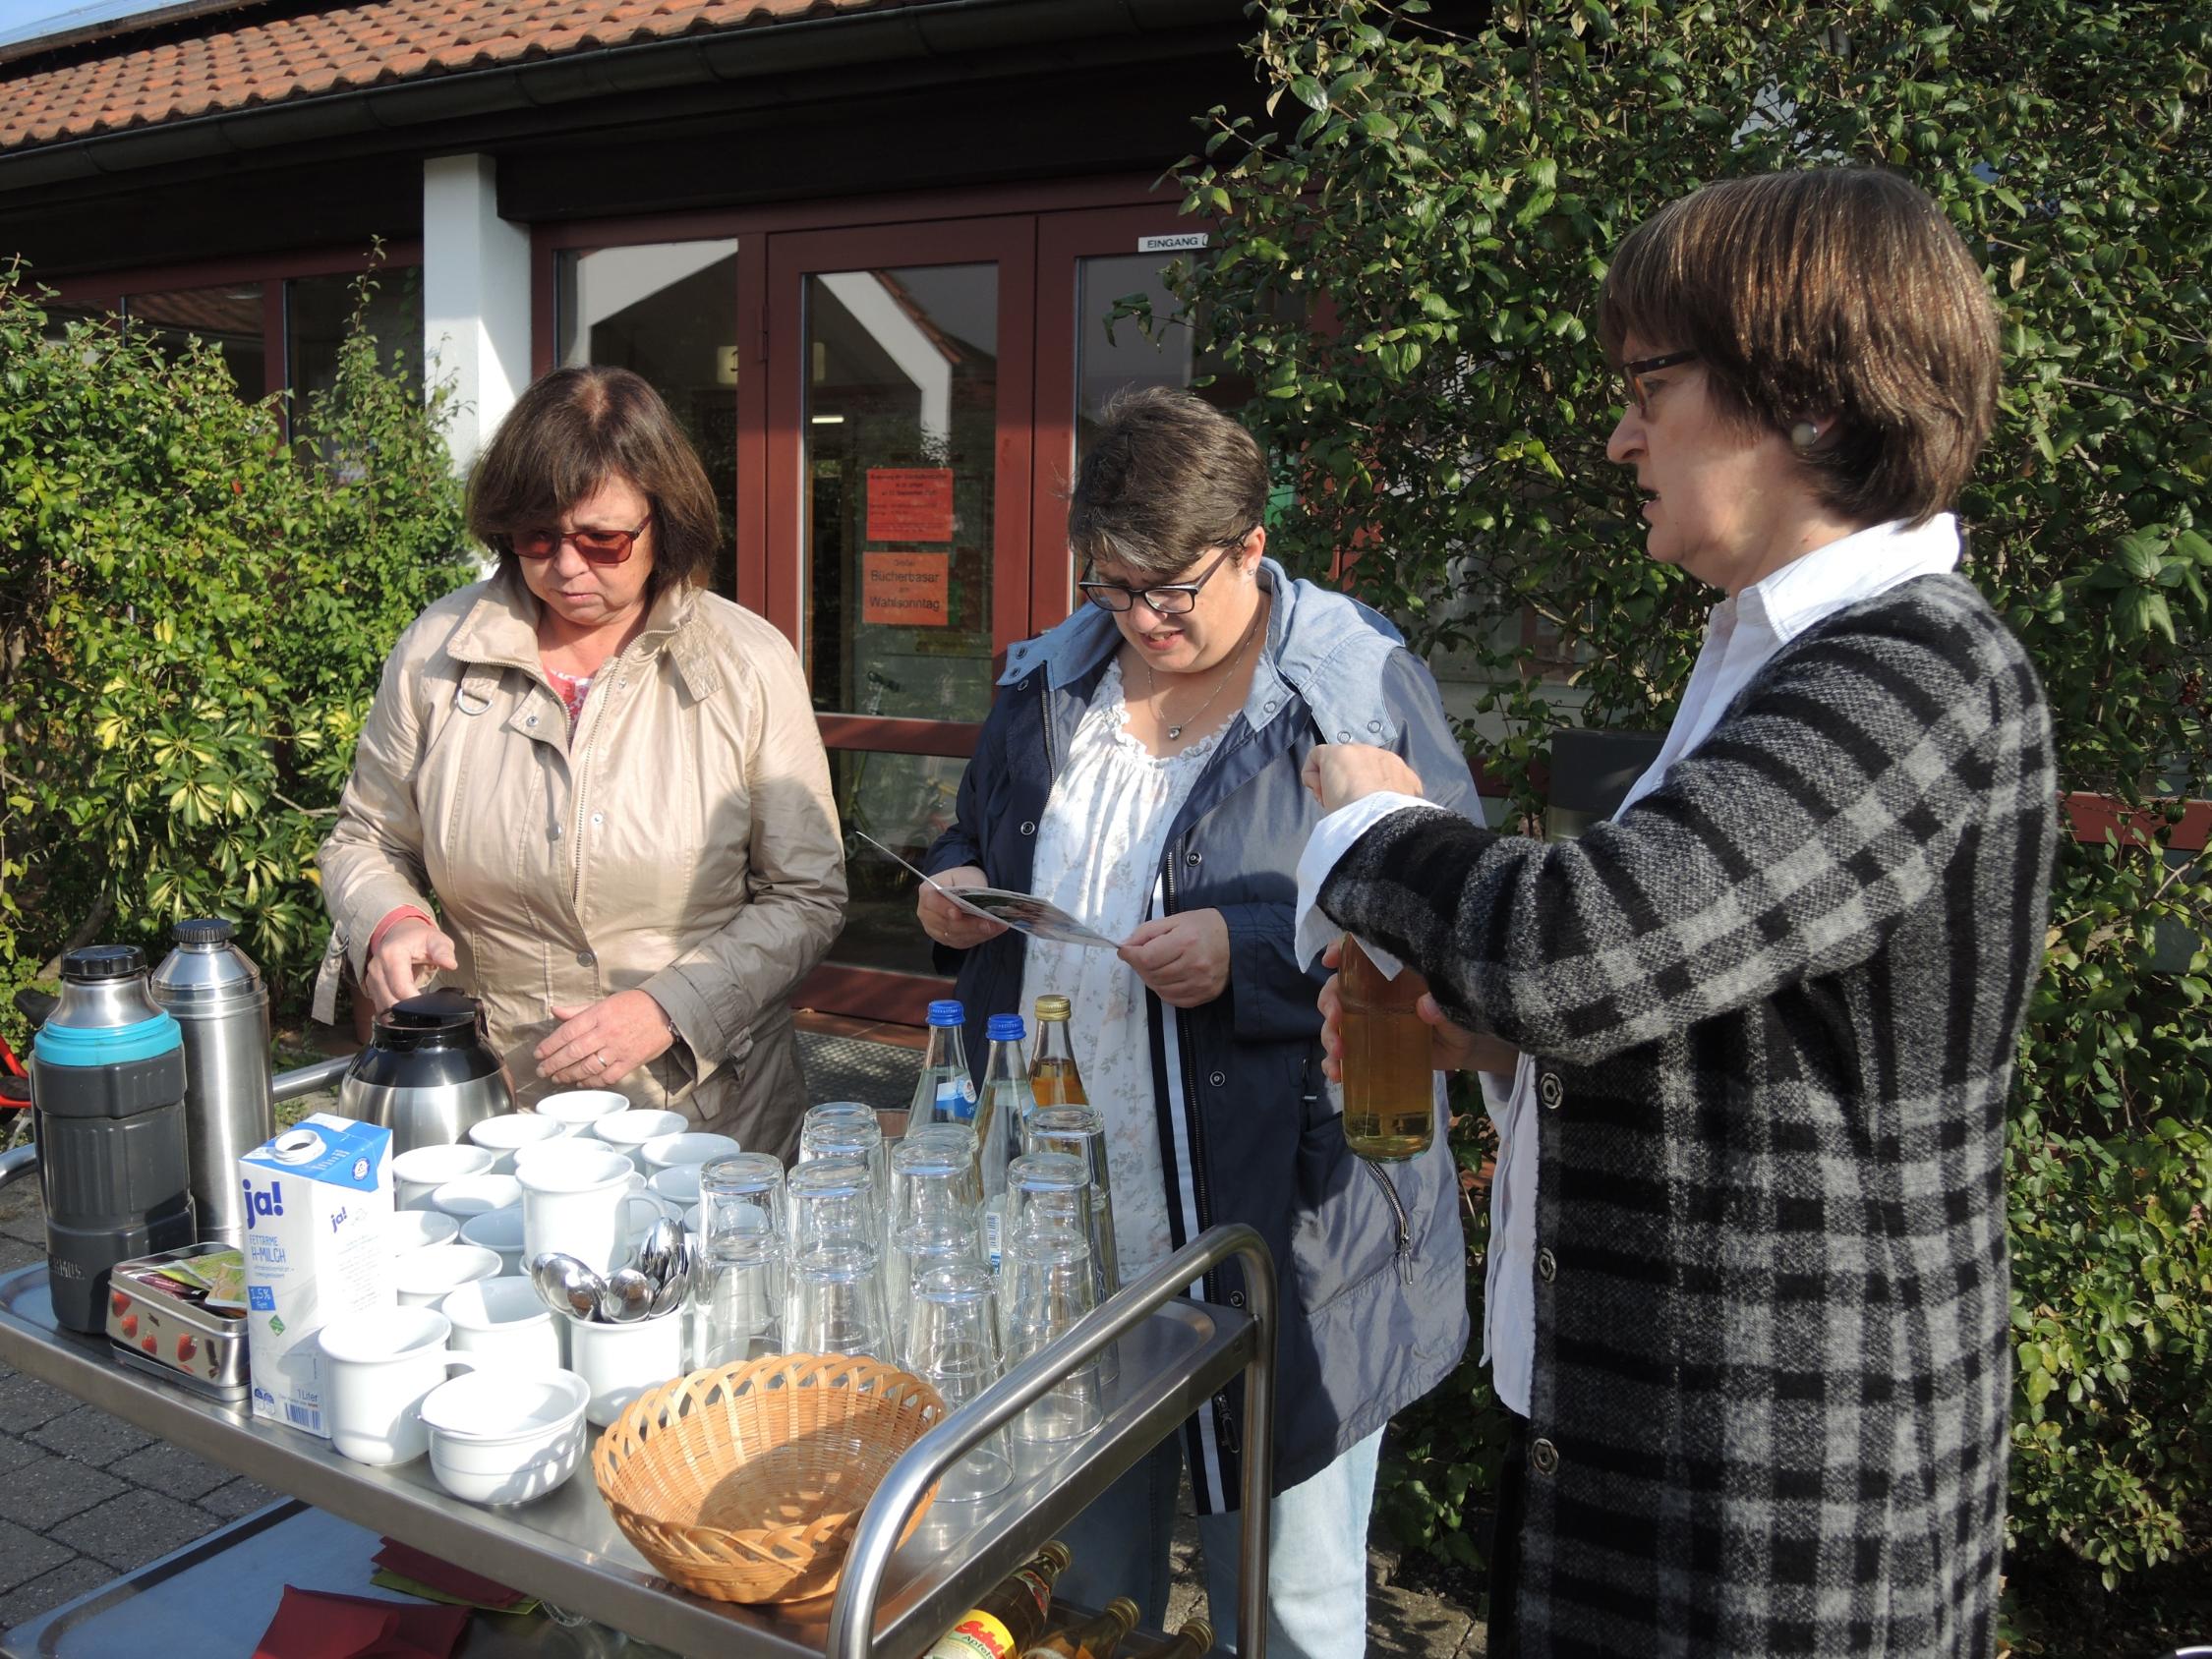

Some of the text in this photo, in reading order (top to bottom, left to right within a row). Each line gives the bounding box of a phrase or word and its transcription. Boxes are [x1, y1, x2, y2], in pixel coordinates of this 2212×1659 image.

[1147, 237, 1198, 249] EINGANG
[869, 596, 941, 612] Wahlsonntag
[242, 1178, 284, 1230] ja!
[330, 1206, 348, 1234] ja!
[252, 1247, 287, 1264] H-MILCH
[961, 1634, 995, 1659] Apfels
